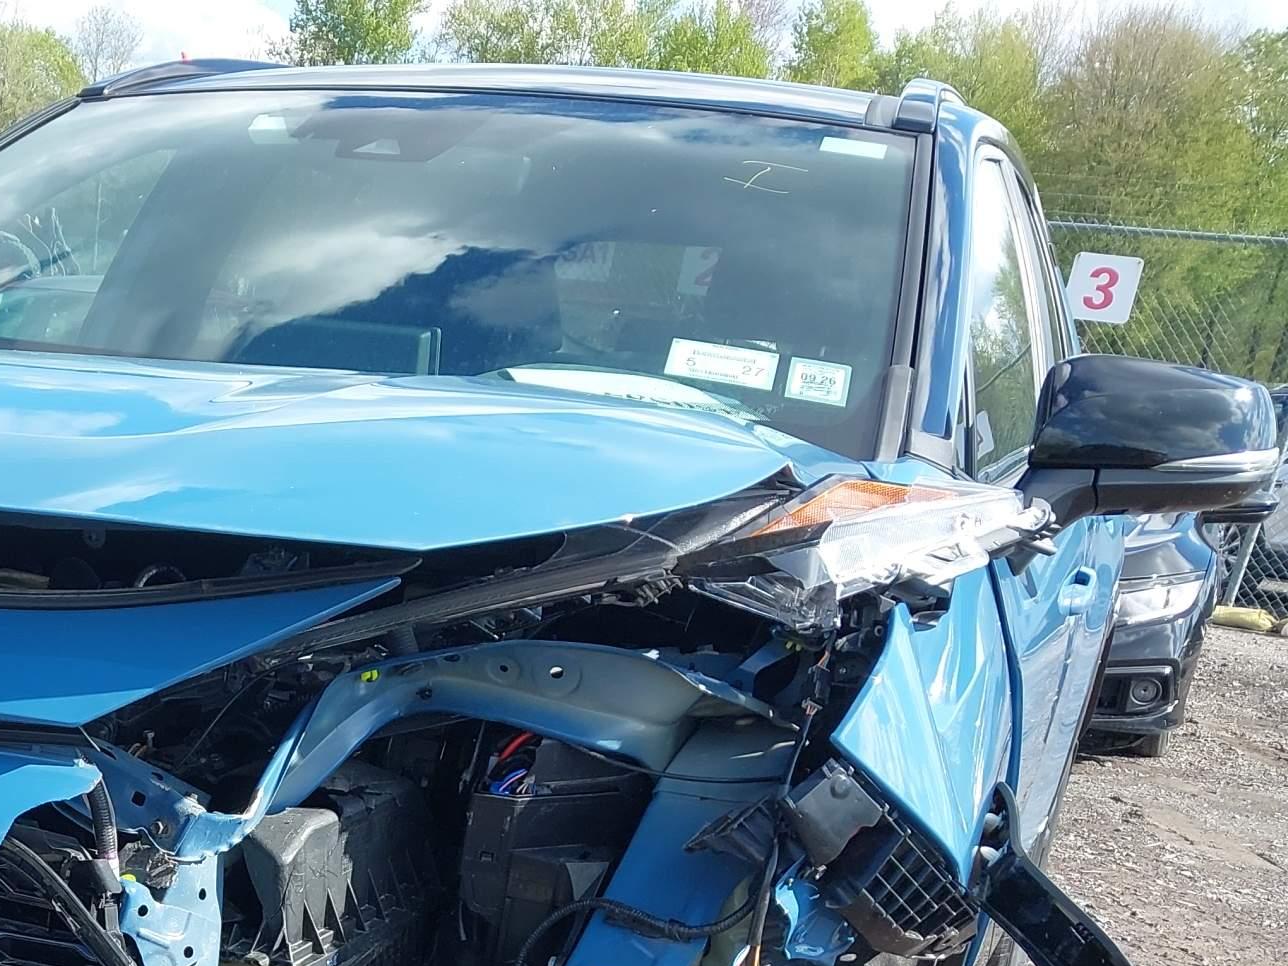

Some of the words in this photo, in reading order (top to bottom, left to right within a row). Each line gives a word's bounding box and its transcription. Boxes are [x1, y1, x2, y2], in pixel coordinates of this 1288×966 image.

[1082, 266, 1120, 310] 3
[686, 357, 696, 367] 5
[741, 365, 766, 377] 27
